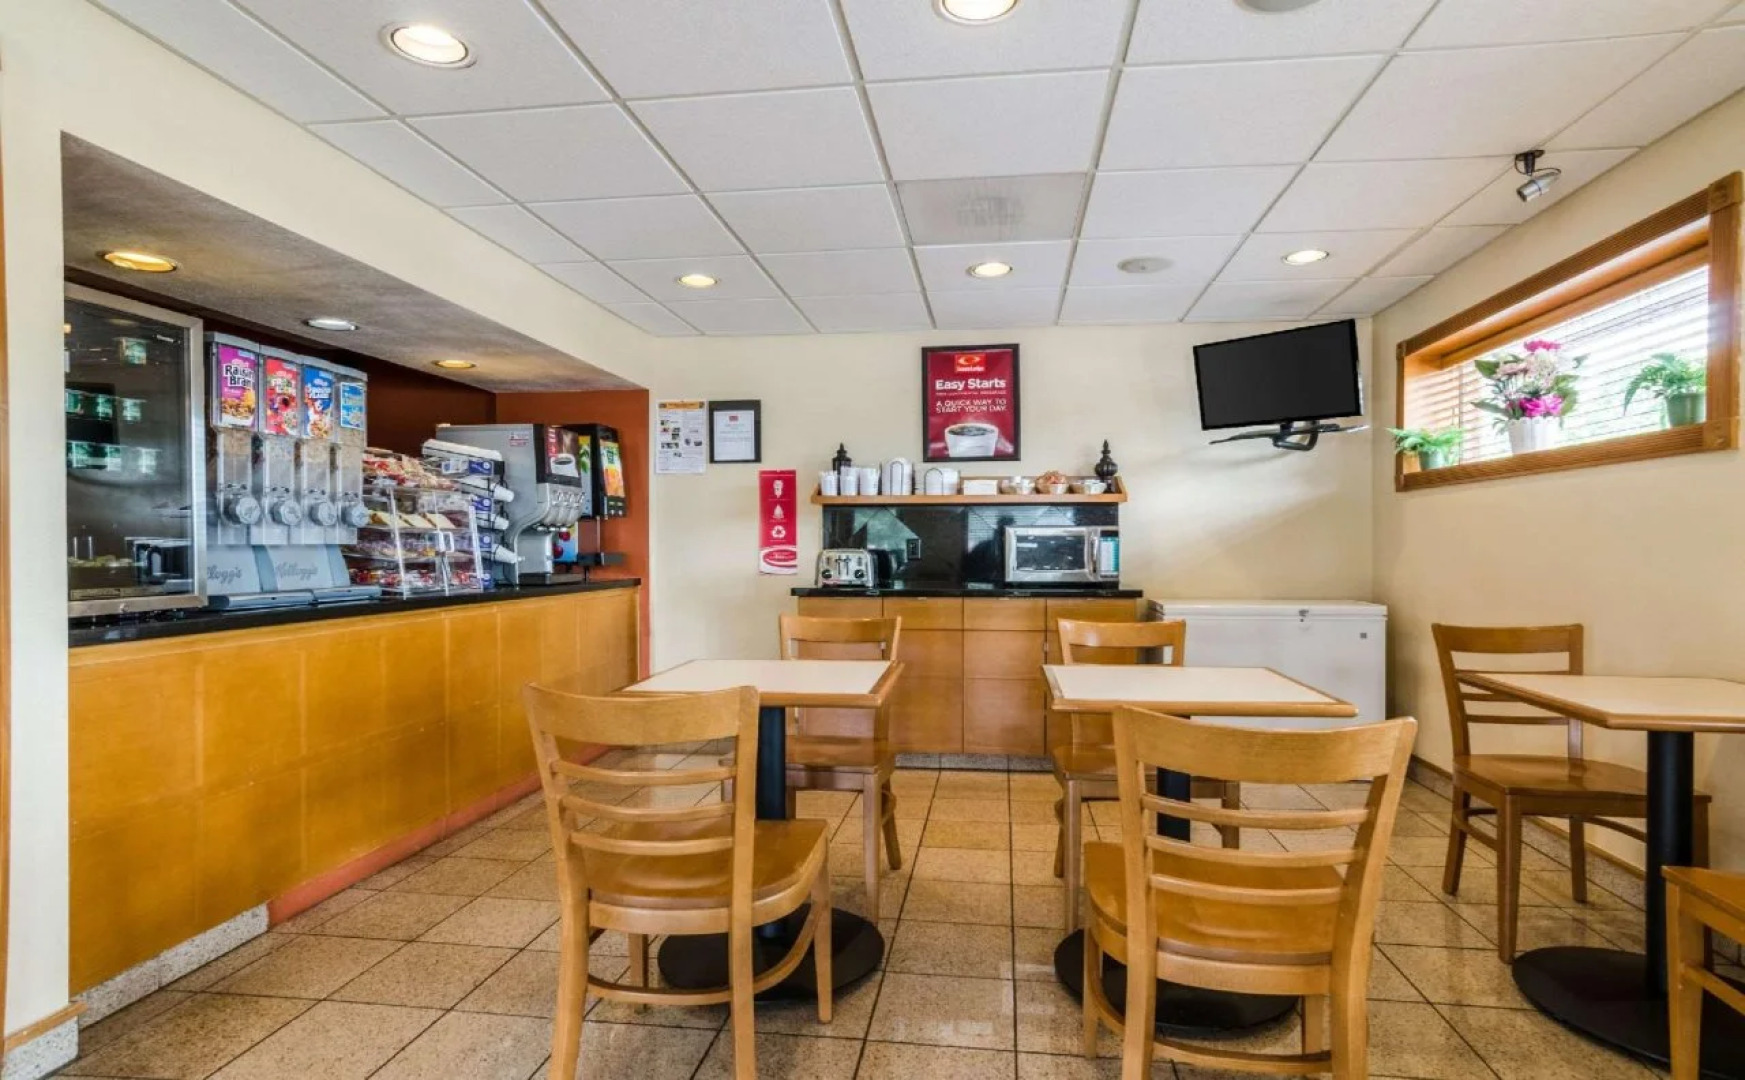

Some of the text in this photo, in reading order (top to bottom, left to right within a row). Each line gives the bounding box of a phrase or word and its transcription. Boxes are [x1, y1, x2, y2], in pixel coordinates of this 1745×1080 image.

[224, 364, 254, 379] Raisin
[229, 375, 254, 388] Bran
[935, 378, 1006, 390] Easy Starts
[945, 399, 971, 407] QUICK
[973, 398, 992, 406] WAY
[964, 405, 988, 413] YOUR
